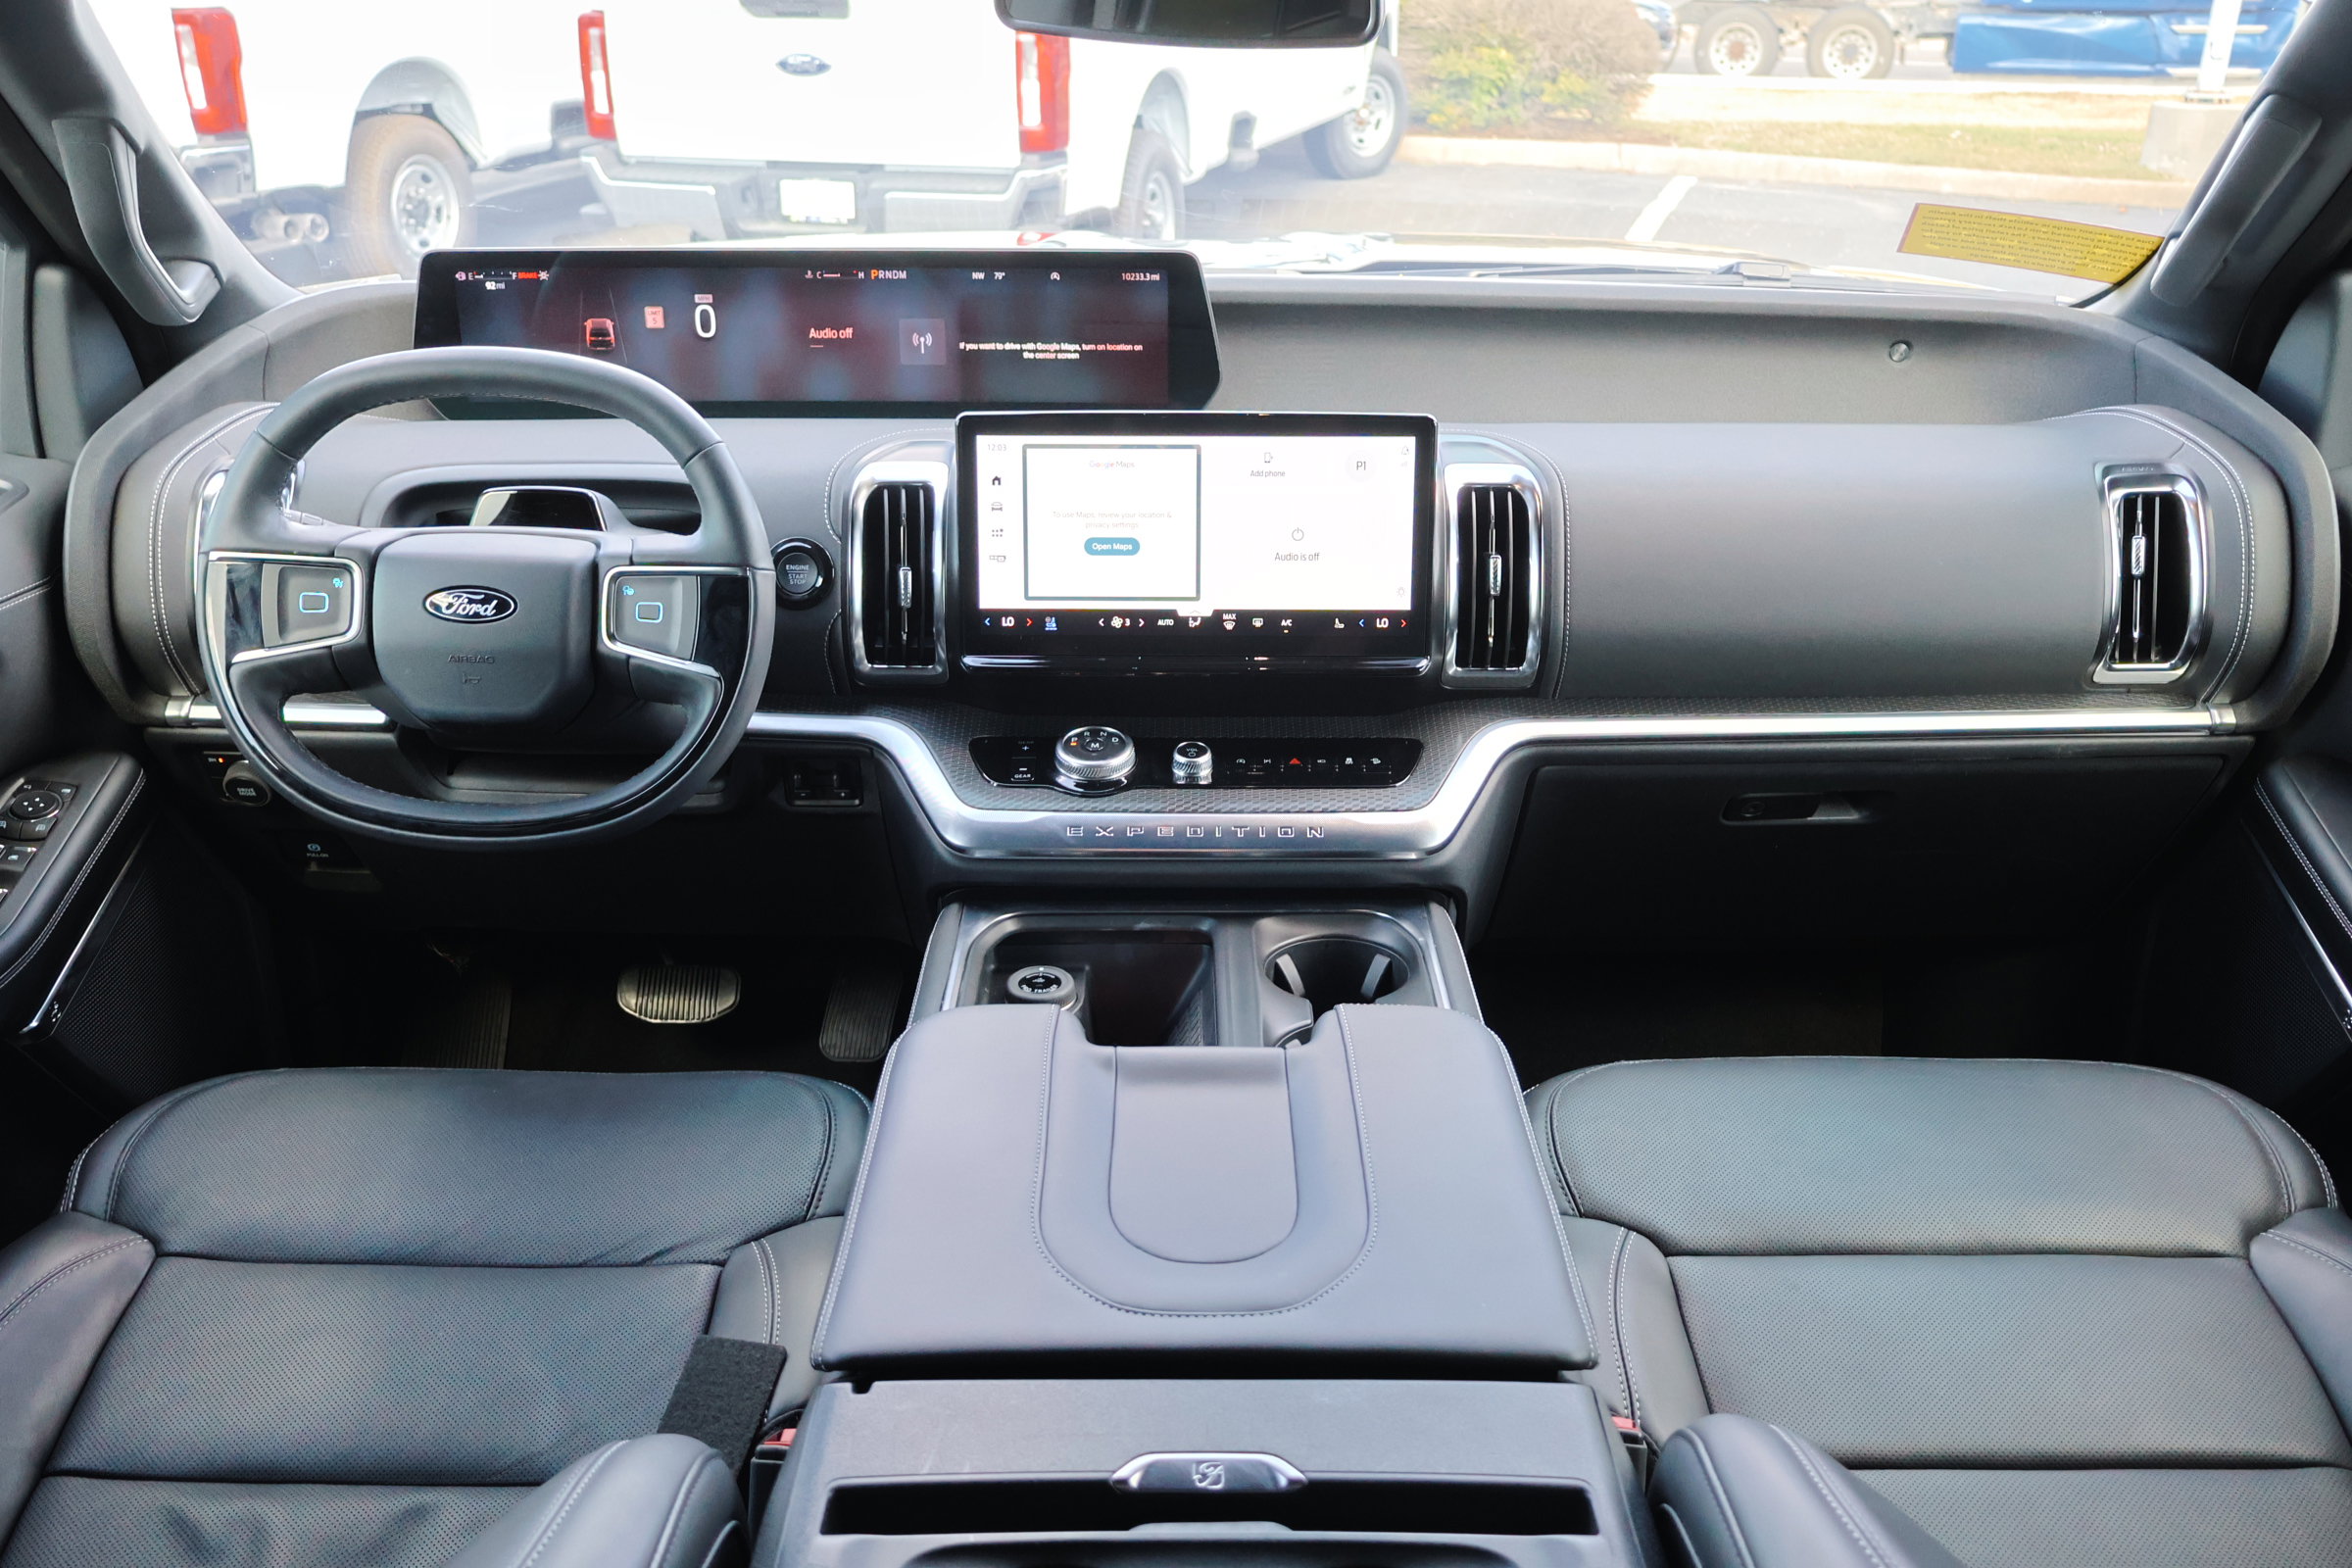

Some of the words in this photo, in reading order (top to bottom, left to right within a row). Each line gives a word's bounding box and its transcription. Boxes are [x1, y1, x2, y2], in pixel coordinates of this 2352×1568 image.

[972, 271, 985, 280] NW
[808, 327, 838, 339] Audio
[839, 327, 854, 339] off
[1036, 342, 1060, 352] Google
[1089, 460, 1115, 469] Google
[1116, 460, 1135, 468] Maps
[1250, 469, 1263, 478] Add
[1085, 521, 1110, 530] privacy
[1111, 521, 1139, 530] settings
[1092, 542, 1112, 551] Open
[1274, 552, 1298, 562] Audio
[1299, 553, 1307, 562] is
[1308, 552, 1320, 562] off
[1002, 616, 1015, 627] LO
[1157, 618, 1174, 627] AUTO
[1281, 618, 1293, 627] A/C
[1376, 617, 1390, 629] LO
[447, 654, 496, 664] AIRBAG
[1066, 825, 1325, 838] EXPEDITION
